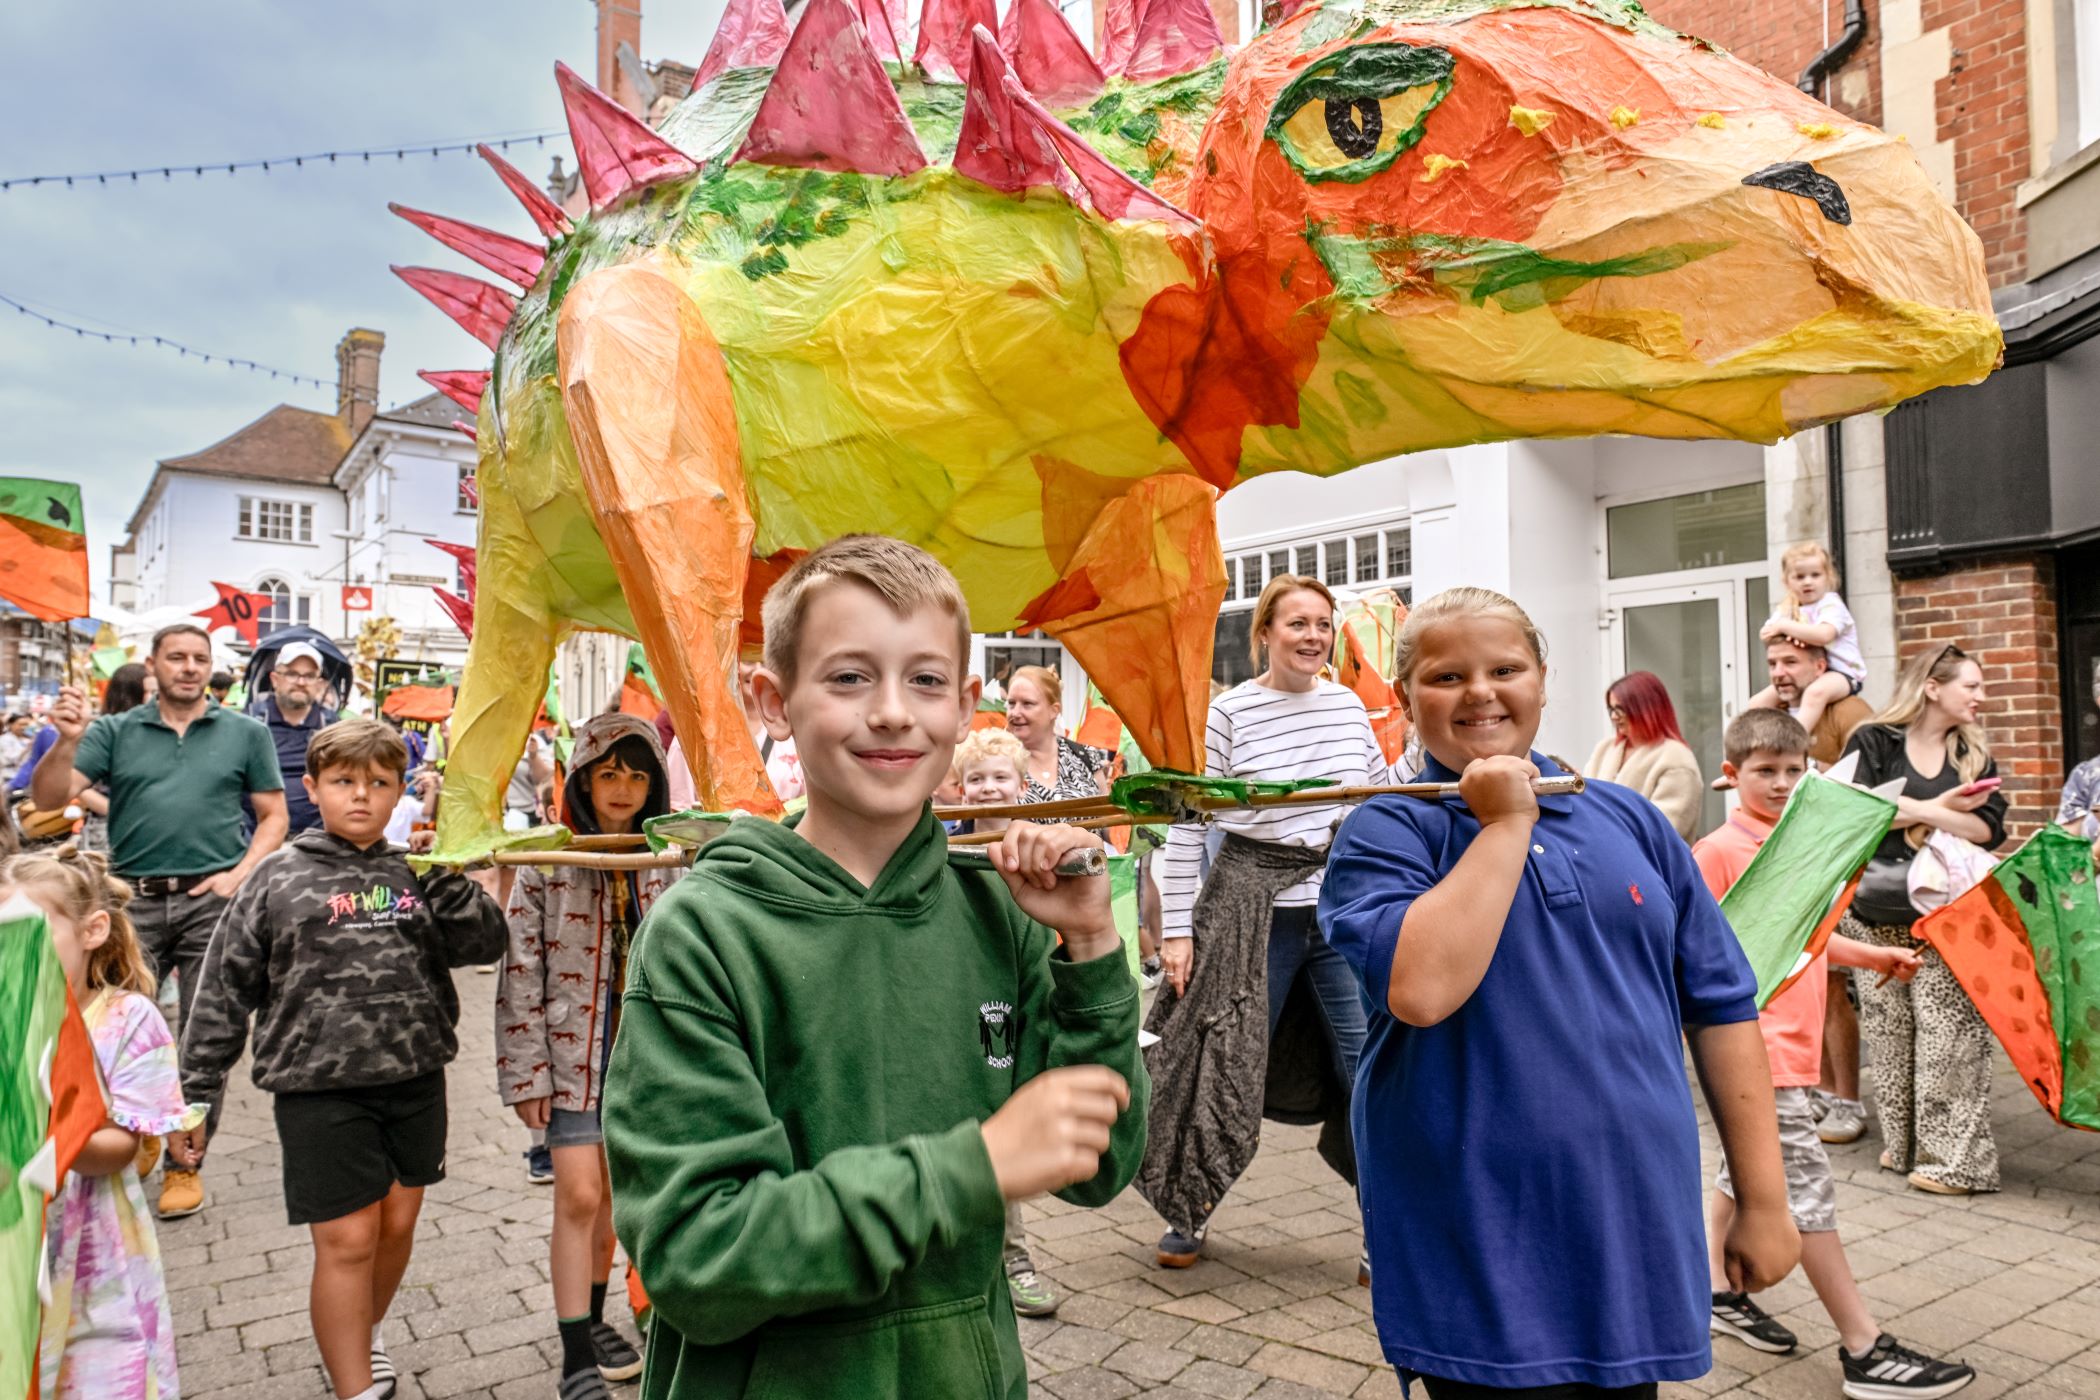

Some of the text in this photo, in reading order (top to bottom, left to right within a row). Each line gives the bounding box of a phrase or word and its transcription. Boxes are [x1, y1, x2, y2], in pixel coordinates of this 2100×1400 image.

[220, 594, 251, 623] 10
[980, 1001, 1012, 1015] WILLIAM
[985, 1013, 1004, 1023] PENN
